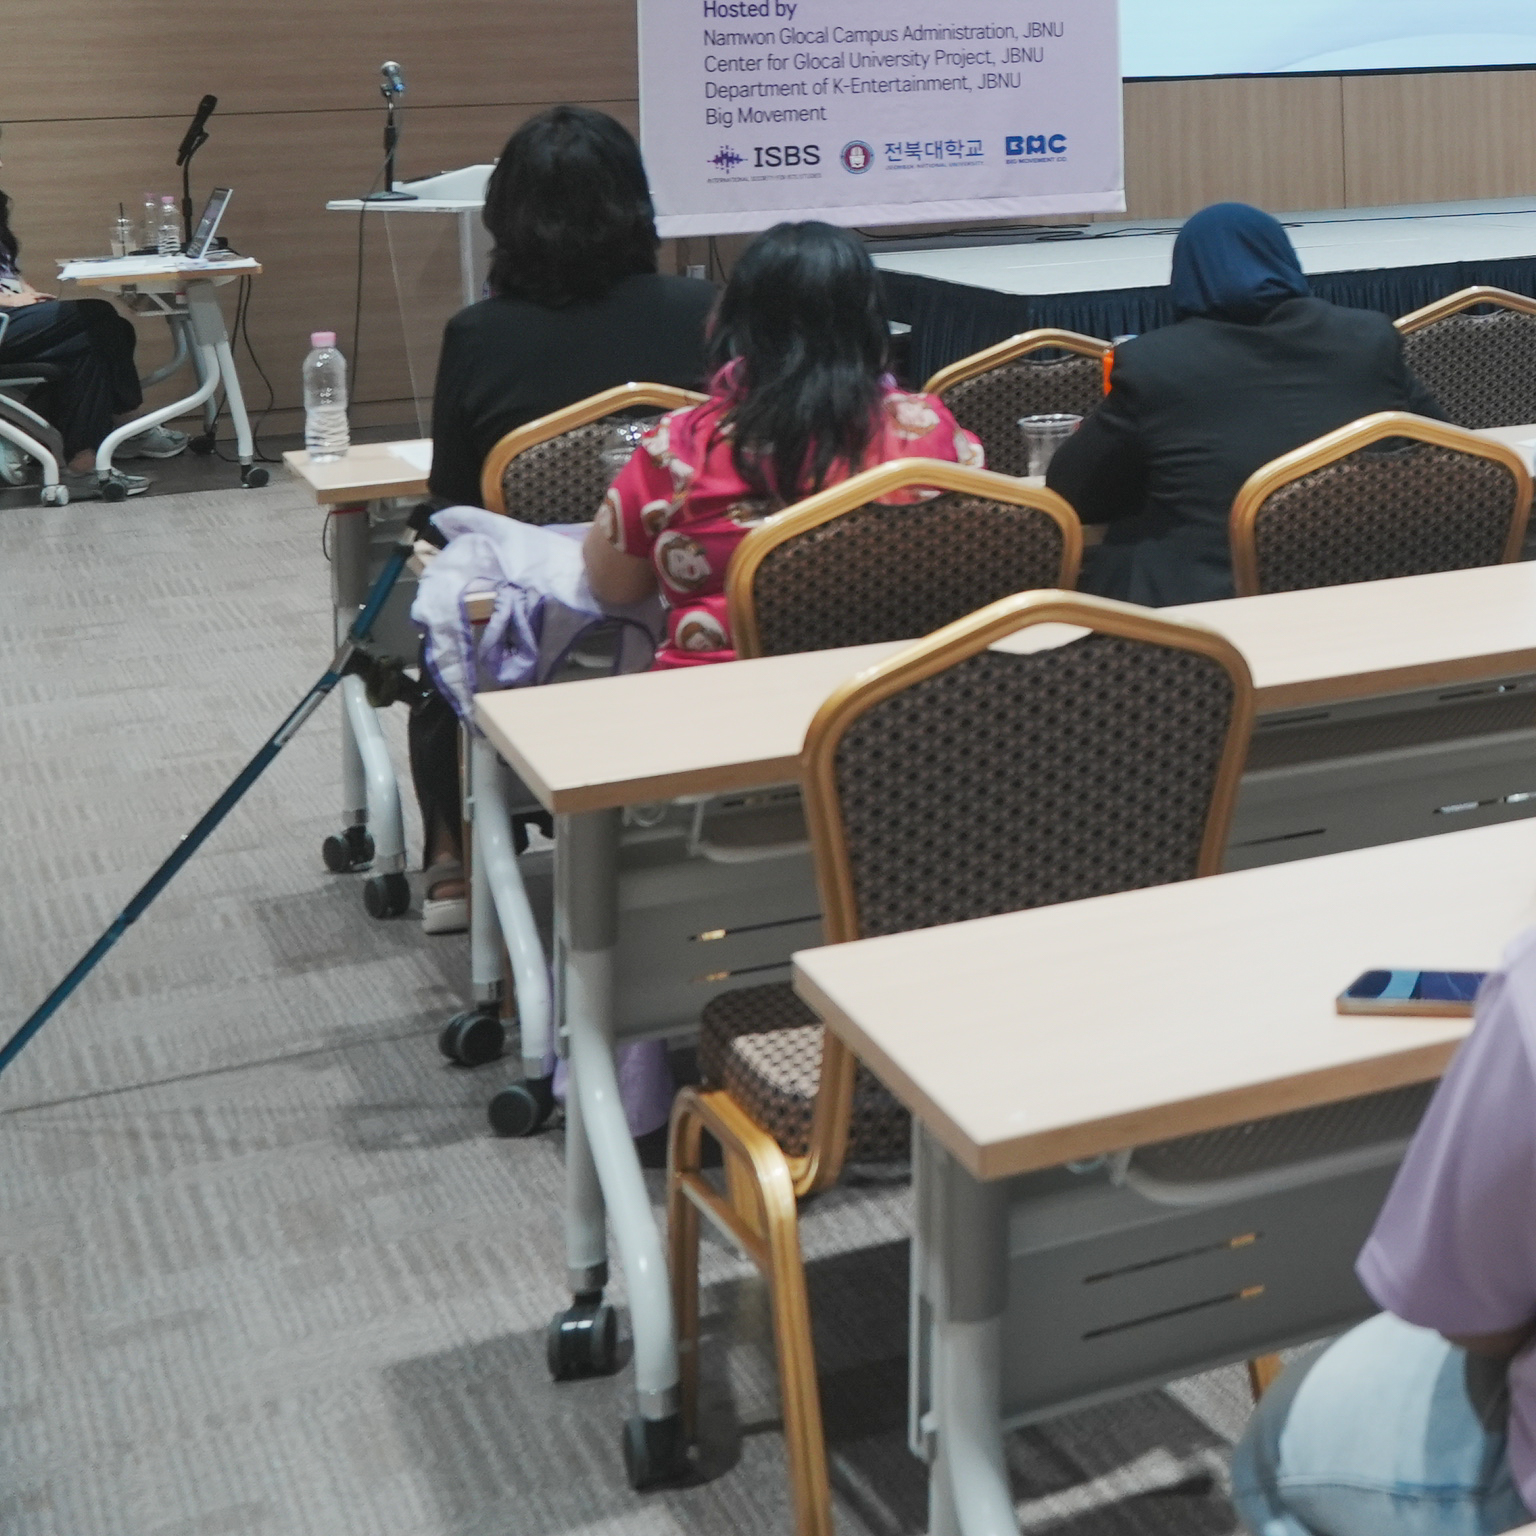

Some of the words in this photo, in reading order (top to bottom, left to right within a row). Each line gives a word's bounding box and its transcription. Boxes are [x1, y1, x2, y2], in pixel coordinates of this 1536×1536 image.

[703, 0, 769, 18] Hosted
[704, 29, 776, 46] Namwon
[779, 27, 829, 45] Glocal
[833, 26, 899, 47] Campus
[903, 23, 1019, 42] Administration,
[1023, 22, 1064, 38] JBNU
[704, 54, 762, 72] Center
[768, 54, 788, 71] for
[794, 52, 845, 70] Glocal
[849, 49, 930, 70] University
[935, 48, 996, 68] Project,
[1001, 47, 1045, 64] JBNU
[705, 80, 808, 102] Department
[812, 78, 830, 95] of
[833, 74, 973, 95] K-Entertainment,
[977, 72, 1022, 89] JBNU
[705, 109, 733, 128] Big
[738, 106, 827, 124] Movement
[754, 145, 821, 167] ISBS
[884, 139, 985, 162] 전북대학교
[1005, 134, 1068, 156] BMC
